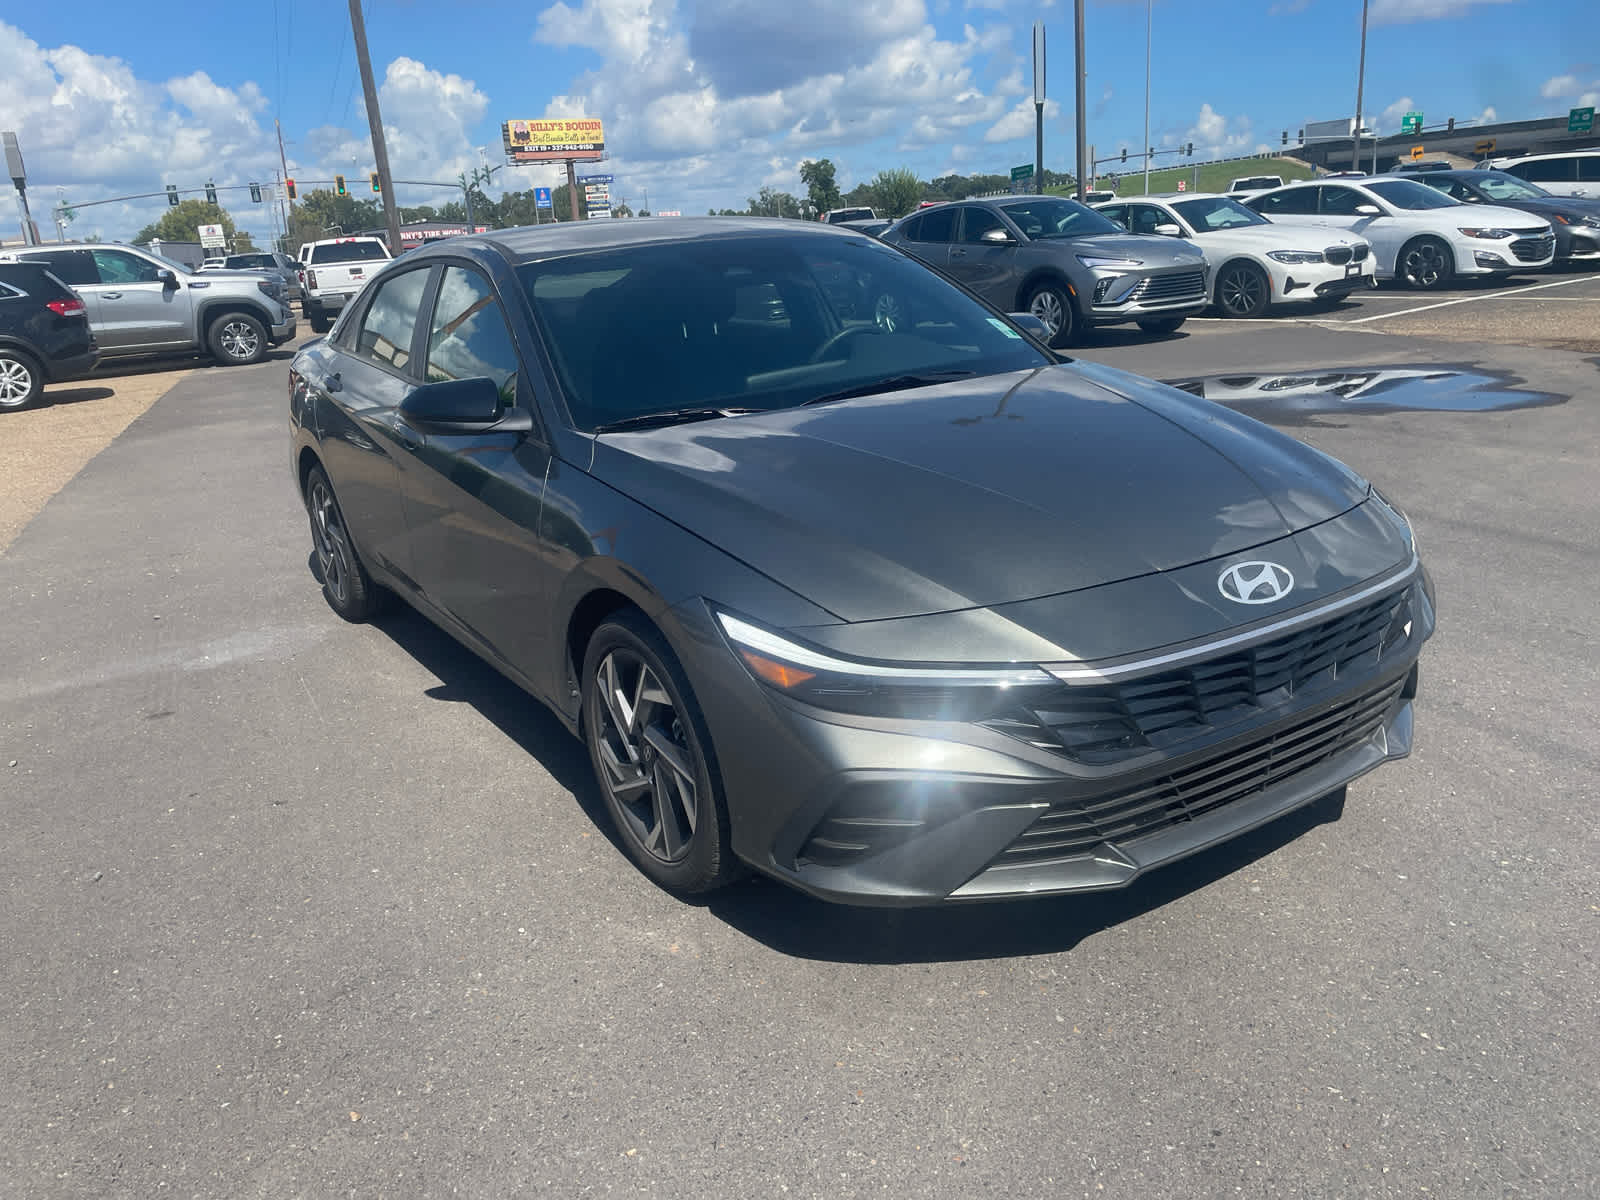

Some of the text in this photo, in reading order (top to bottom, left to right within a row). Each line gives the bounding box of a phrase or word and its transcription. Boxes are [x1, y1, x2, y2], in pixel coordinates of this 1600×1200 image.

[530, 122, 600, 131] BILLY'S BOUDIN
[400, 231, 423, 240] NNY'S
[423, 229, 440, 238] TIRE
